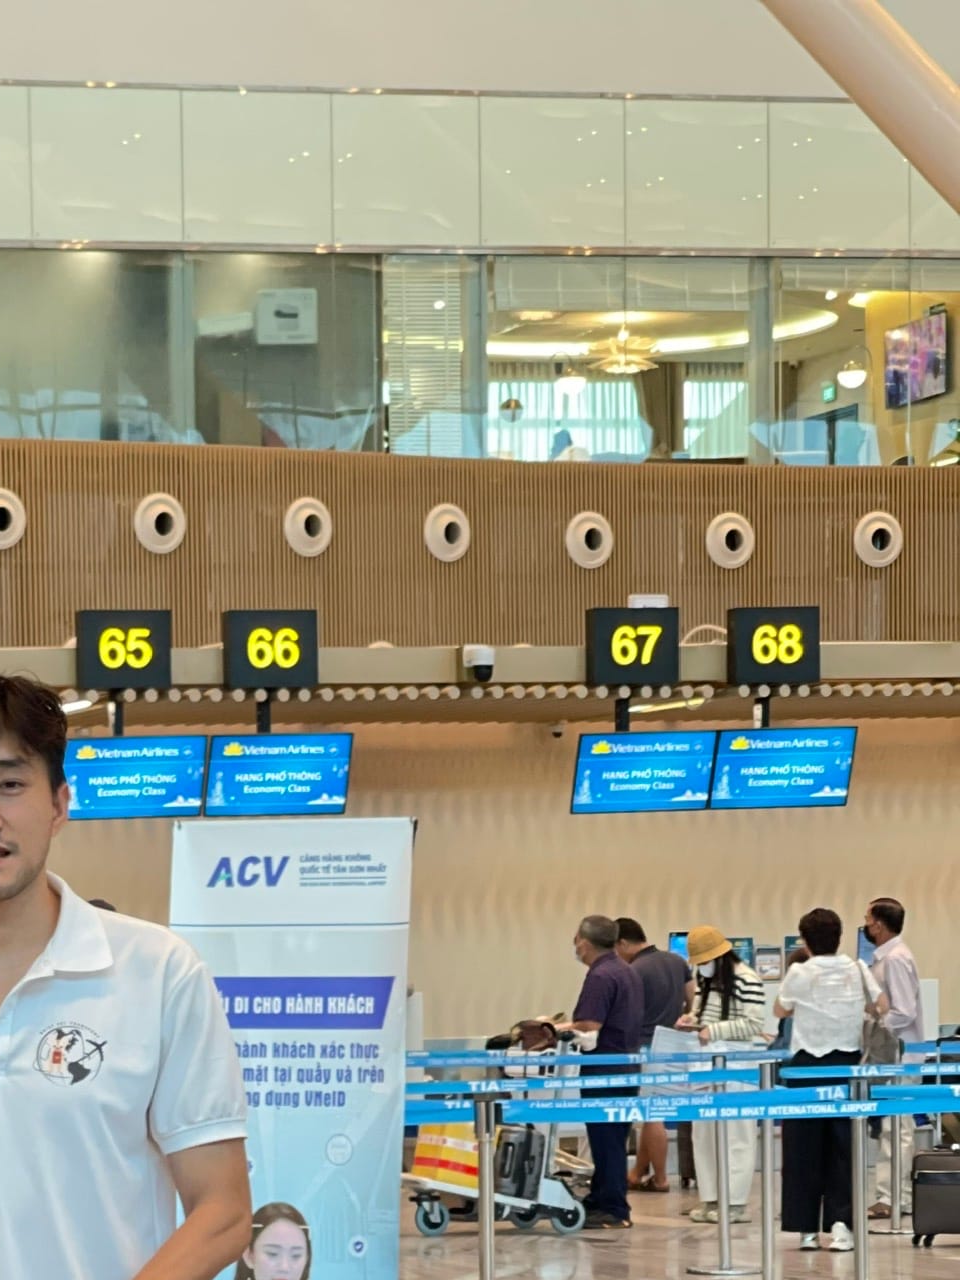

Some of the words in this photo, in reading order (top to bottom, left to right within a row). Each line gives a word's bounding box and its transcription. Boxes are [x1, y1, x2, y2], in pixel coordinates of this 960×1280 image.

[98, 627, 153, 669] 65
[246, 627, 301, 669] 66
[611, 625, 662, 665] 67
[751, 624, 803, 664] 68
[244, 746, 287, 755] Vietnam
[287, 745, 324, 754] Airlines
[612, 744, 653, 753] Vietnam
[653, 742, 690, 752] Airlines
[750, 739, 792, 749] Vietnam
[792, 738, 828, 748] Airlines
[97, 748, 140, 758] Vietnam
[140, 747, 179, 757] Airlines
[243, 785, 286, 795] Economy
[288, 784, 311, 793] Class
[610, 783, 651, 792] Economy
[652, 781, 674, 790] Class
[748, 778, 790, 788] Economy
[791, 777, 814, 786] Class
[97, 788, 141, 798] Economy
[142, 787, 166, 796] Class
[206, 856, 290, 887] ACV
[253, 996, 282, 1014] CHO
[327, 993, 374, 1014] KHÁCH
[272, 1041, 316, 1058] khách
[320, 1040, 345, 1059] xác
[850, 1066, 879, 1076] TIA
[468, 1081, 500, 1092] TIA
[816, 1086, 845, 1100] TIA
[246, 1092, 260, 1108] ng
[265, 1090, 300, 1110] dụng
[604, 1107, 643, 1122] TIA
[698, 1108, 717, 1118] TAN
[720, 1107, 738, 1117] SON
[740, 1106, 765, 1116] NHAT
[768, 1104, 837, 1115] INTERNATIONAL
[840, 1102, 878, 1112] AIRPORT
